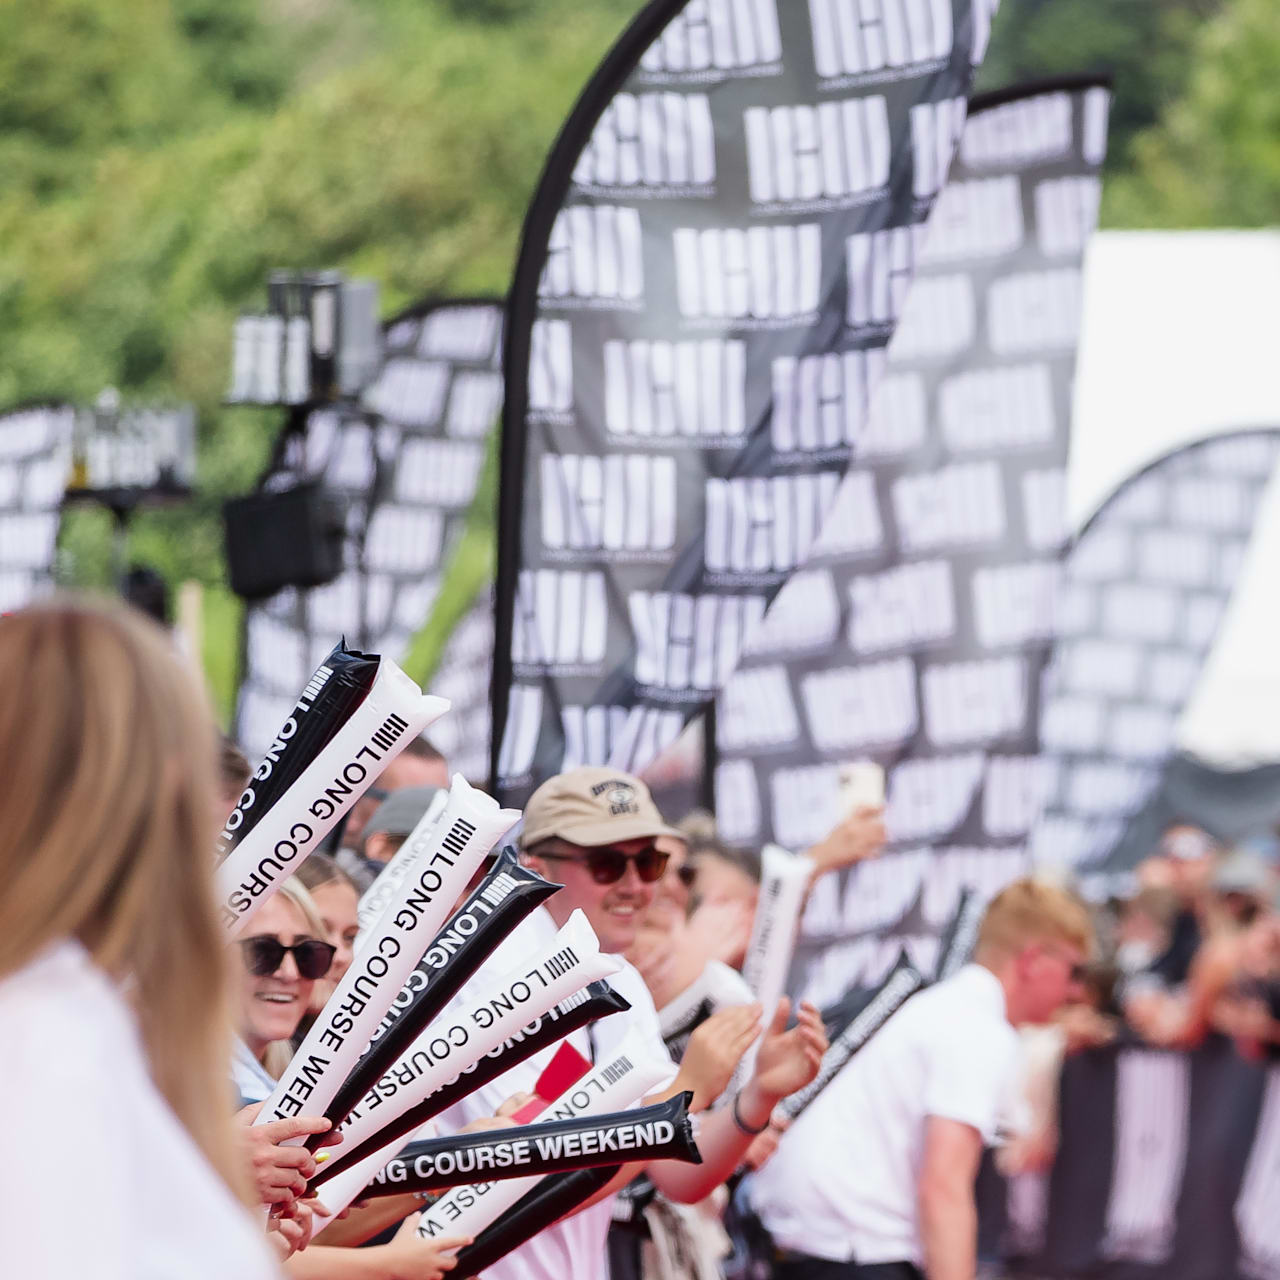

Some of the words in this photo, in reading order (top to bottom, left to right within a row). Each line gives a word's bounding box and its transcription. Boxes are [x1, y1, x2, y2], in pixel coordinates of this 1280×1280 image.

[254, 701, 310, 781] LONG
[308, 745, 382, 820] LONG
[393, 851, 454, 931] LONG
[422, 901, 492, 969] LONG
[319, 936, 400, 1052] COURSE
[470, 969, 548, 1029] LONG
[365, 1025, 469, 1111] COURSE
[543, 1079, 606, 1122] LON
[367, 1159, 408, 1187] NG
[414, 1140, 531, 1179] COURSE
[536, 1121, 675, 1161] WEEKEND
